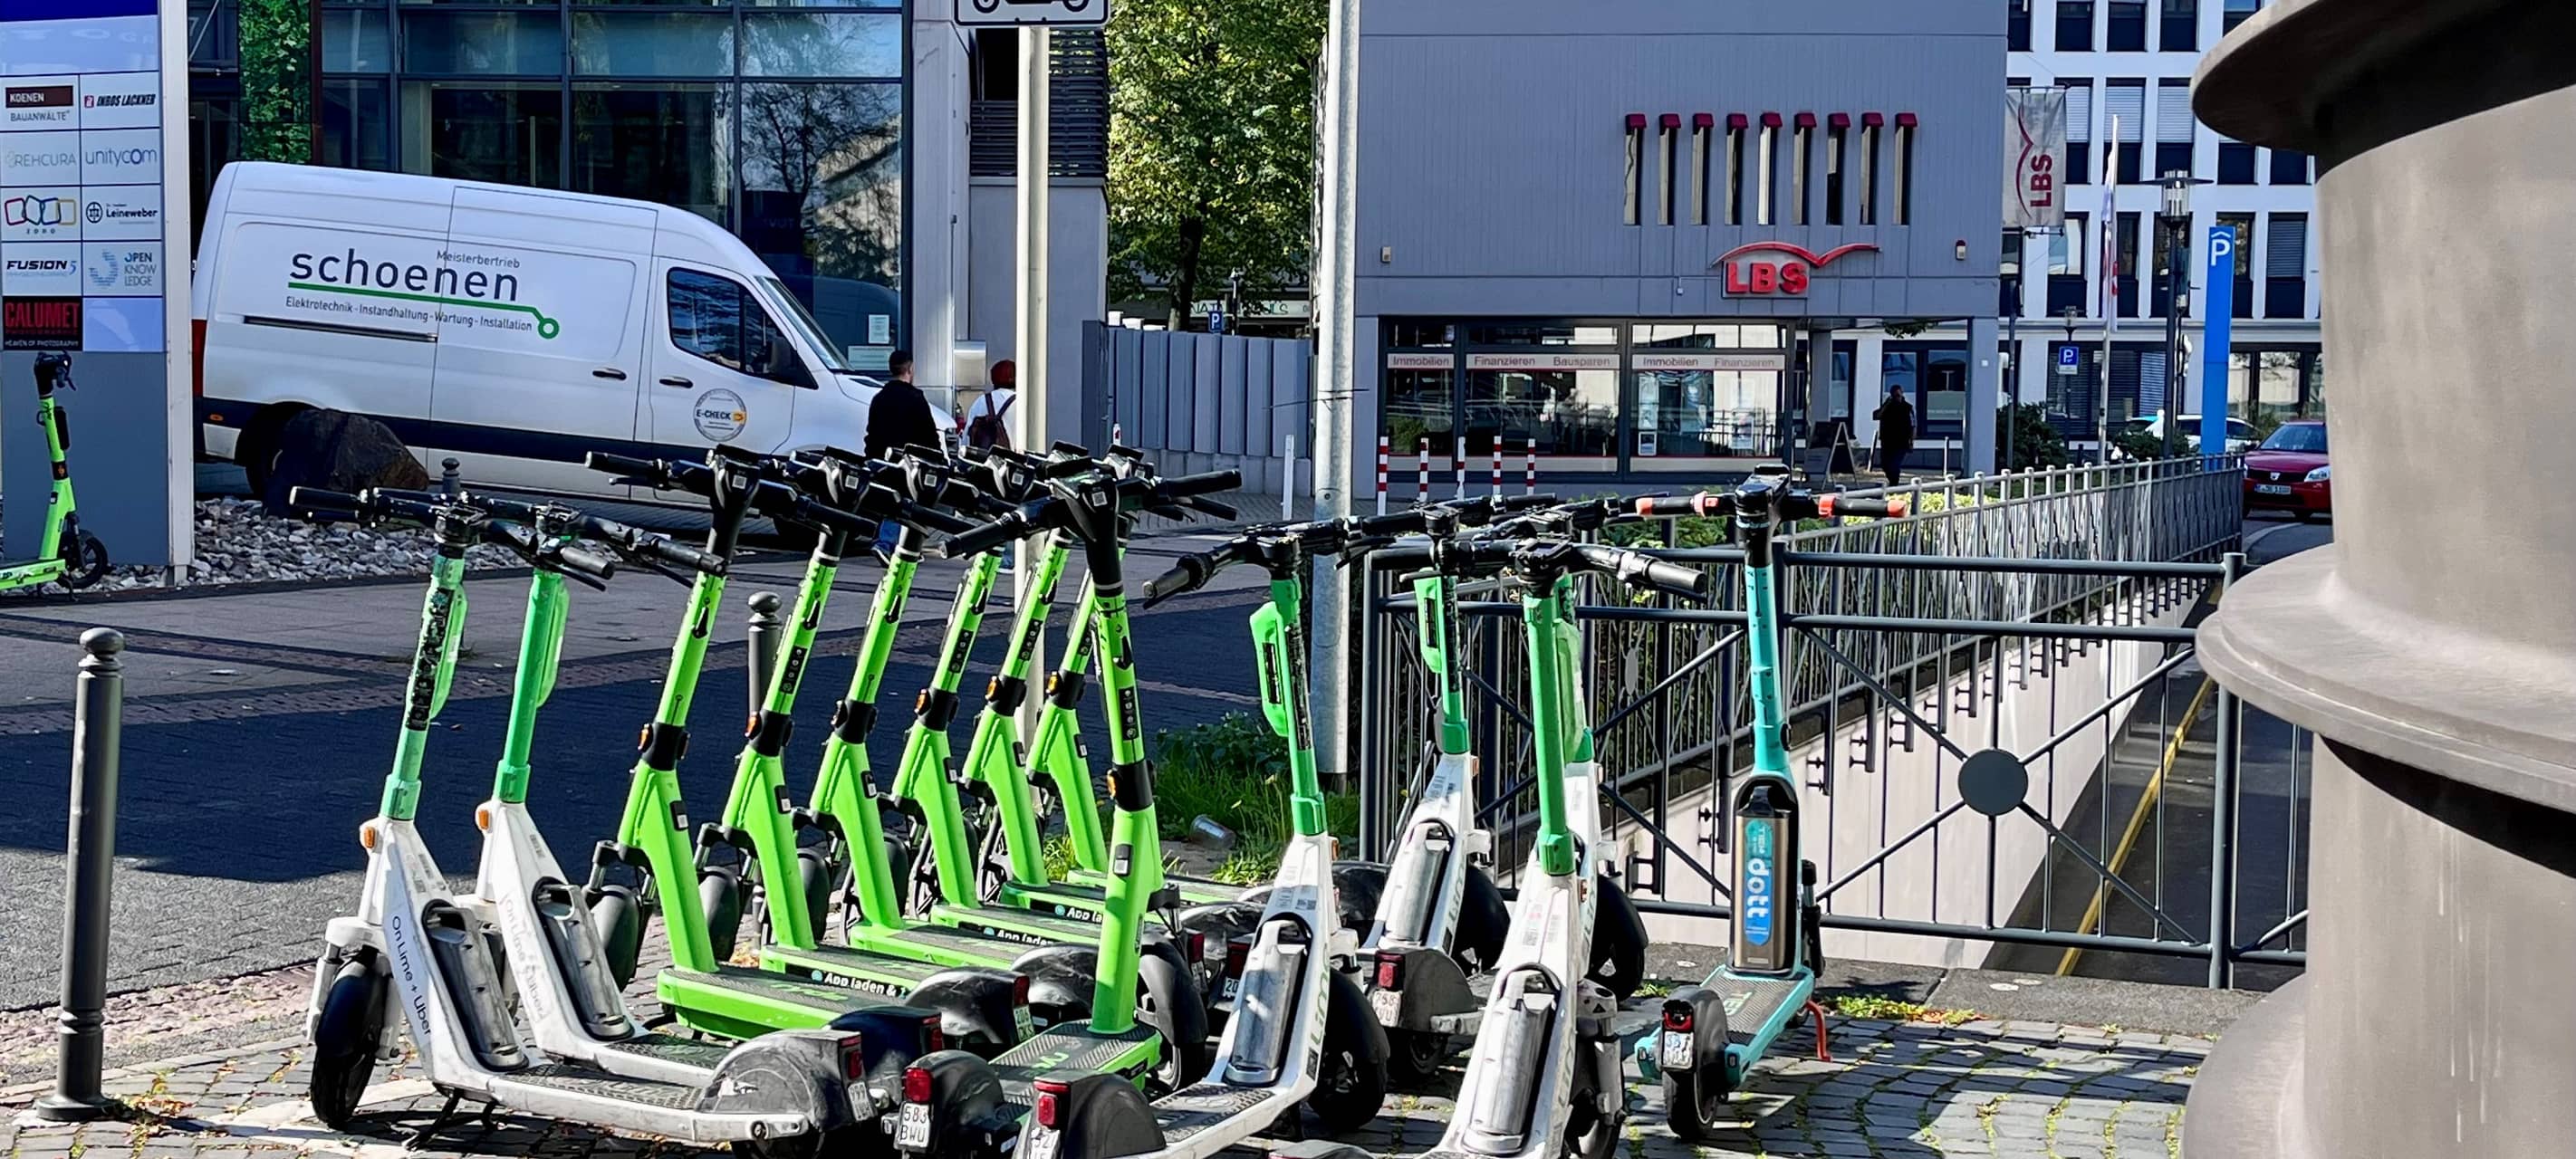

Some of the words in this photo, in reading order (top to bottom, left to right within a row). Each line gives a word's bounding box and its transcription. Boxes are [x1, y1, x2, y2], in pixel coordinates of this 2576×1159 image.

[9, 92, 44, 103] KOENEN
[85, 148, 157, 168] unitycom
[2030, 154, 2052, 207] LBS
[106, 207, 158, 217] Leineweber
[124, 253, 152, 263] OPEN
[2211, 239, 2231, 266] P
[7, 260, 67, 270] FUSION
[69, 260, 77, 275] 5
[124, 263, 156, 274] KNOW
[289, 248, 518, 302] schoenen
[124, 275, 152, 287] LEDGE
[1725, 262, 1808, 295] LBS
[5, 302, 80, 328] CALUMET
[285, 296, 353, 313] Elektrotechnik
[359, 303, 428, 323] Instandhaltung
[435, 311, 473, 328] Wartung
[480, 315, 533, 331] Installation
[1211, 313, 1220, 329] P
[1392, 356, 1449, 367] Immobilien
[1474, 356, 1535, 367] Finanzieren
[1552, 356, 1610, 369] Bausparen
[1643, 357, 1699, 367] Immobilien
[1714, 357, 1775, 368] Finanzieren
[2063, 349, 2074, 363] P
[696, 409, 731, 420] E-CHECK
[1747, 857, 1770, 919] dott
[392, 915, 402, 942] On
[398, 941, 413, 982] Lime
[413, 994, 431, 1035] Uber
[851, 977, 885, 995] laden
[1226, 980, 1239, 993] 20
